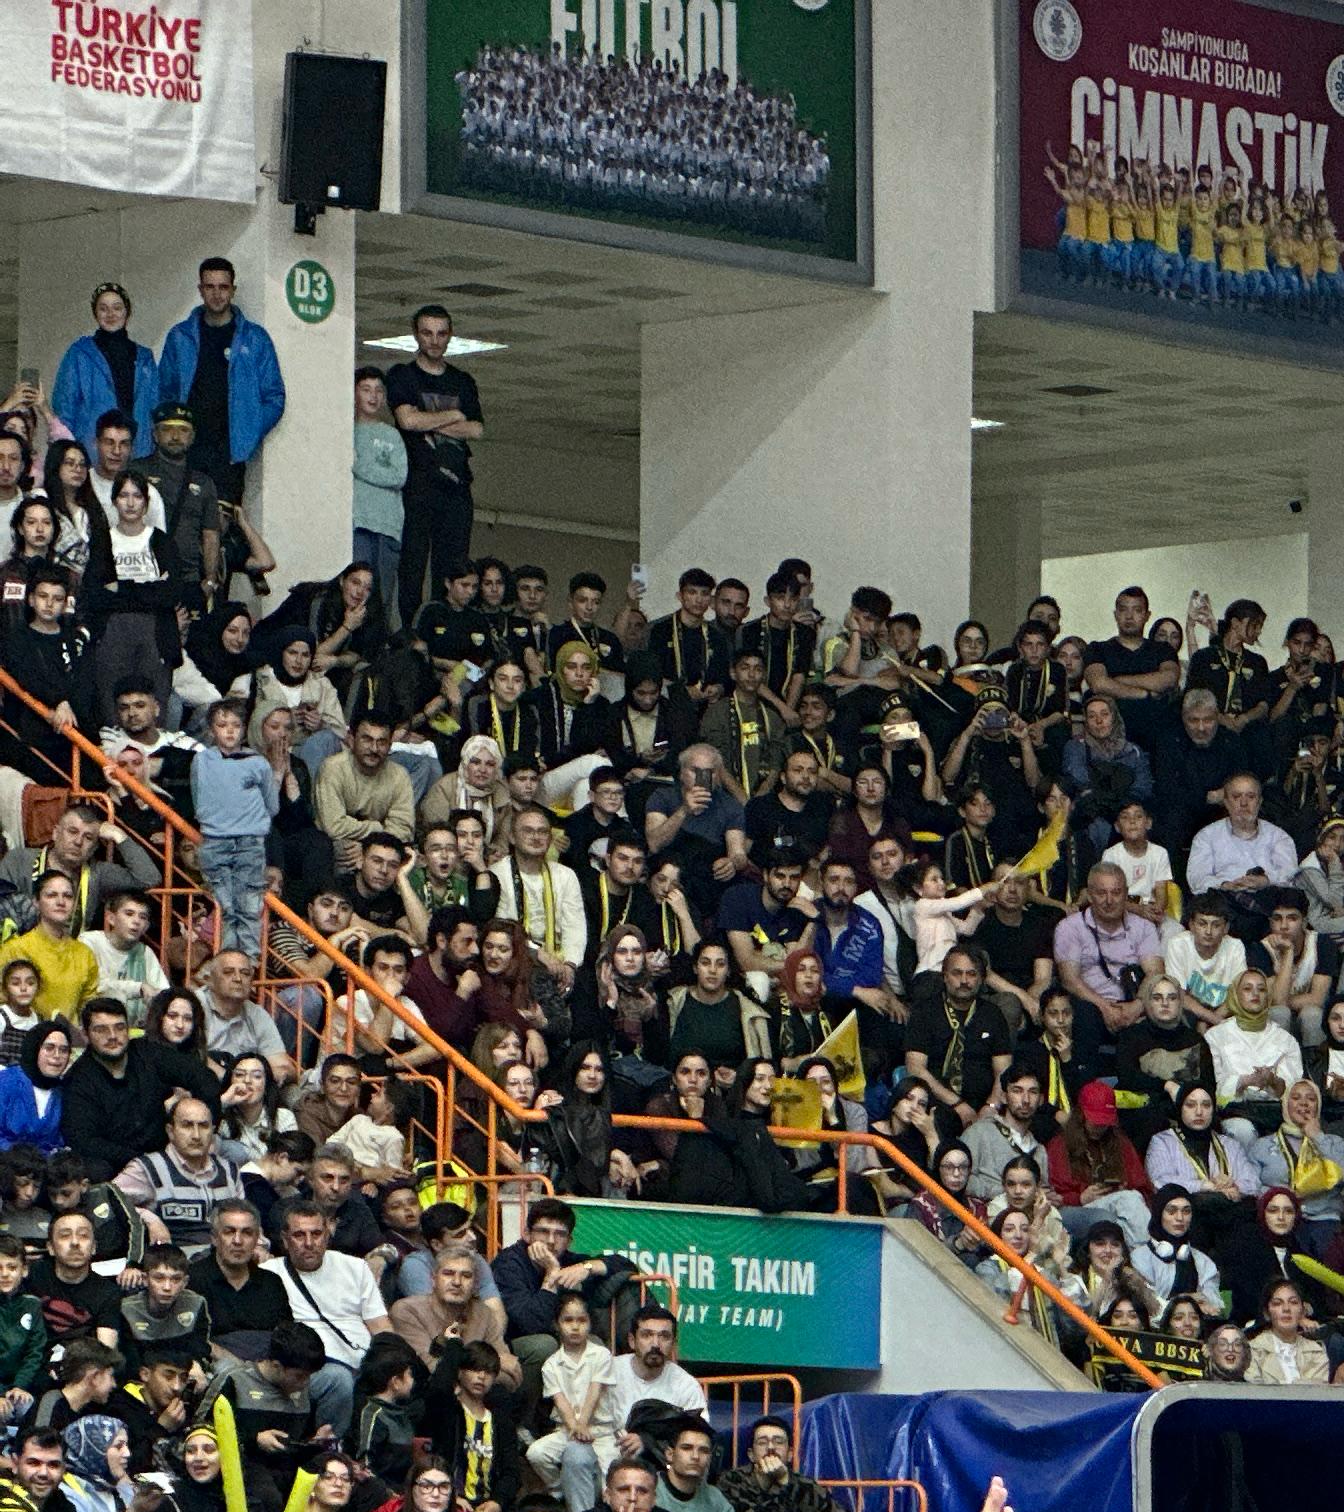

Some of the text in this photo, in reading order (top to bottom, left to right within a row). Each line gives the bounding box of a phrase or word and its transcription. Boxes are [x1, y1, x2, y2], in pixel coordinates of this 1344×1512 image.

[53, 0, 201, 52] TÜRKİYE
[52, 34, 201, 80] BASKETBOL
[1128, 42, 1210, 85] KOŞANLAR
[1214, 63, 1282, 99] BURADA!
[52, 62, 202, 102] FEDERASYONU
[293, 267, 328, 302] D3
[731, 1256, 815, 1296] TAKIM
[720, 1306, 783, 1332] TEAM)
